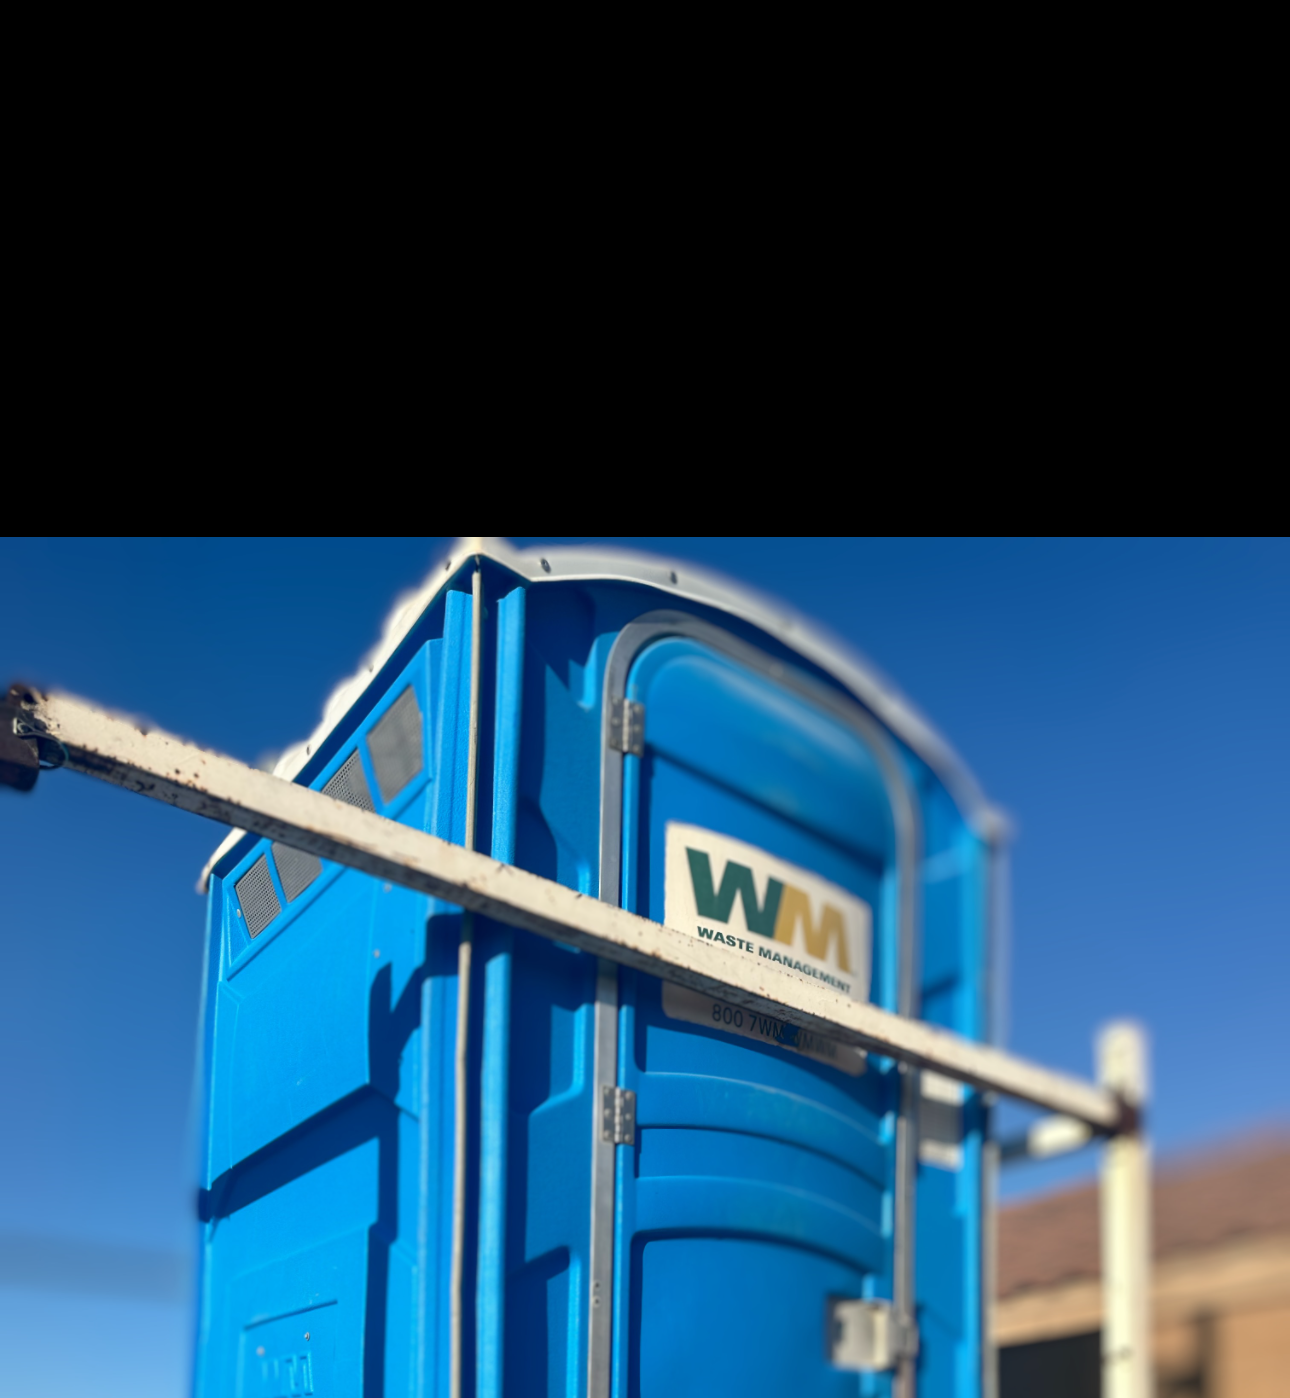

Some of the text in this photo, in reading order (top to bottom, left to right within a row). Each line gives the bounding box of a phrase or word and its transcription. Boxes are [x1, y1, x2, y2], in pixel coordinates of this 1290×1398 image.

[685, 846, 852, 975] WM
[697, 926, 851, 994] WASTE MANAGEMENT
[712, 1003, 744, 1029] 800
